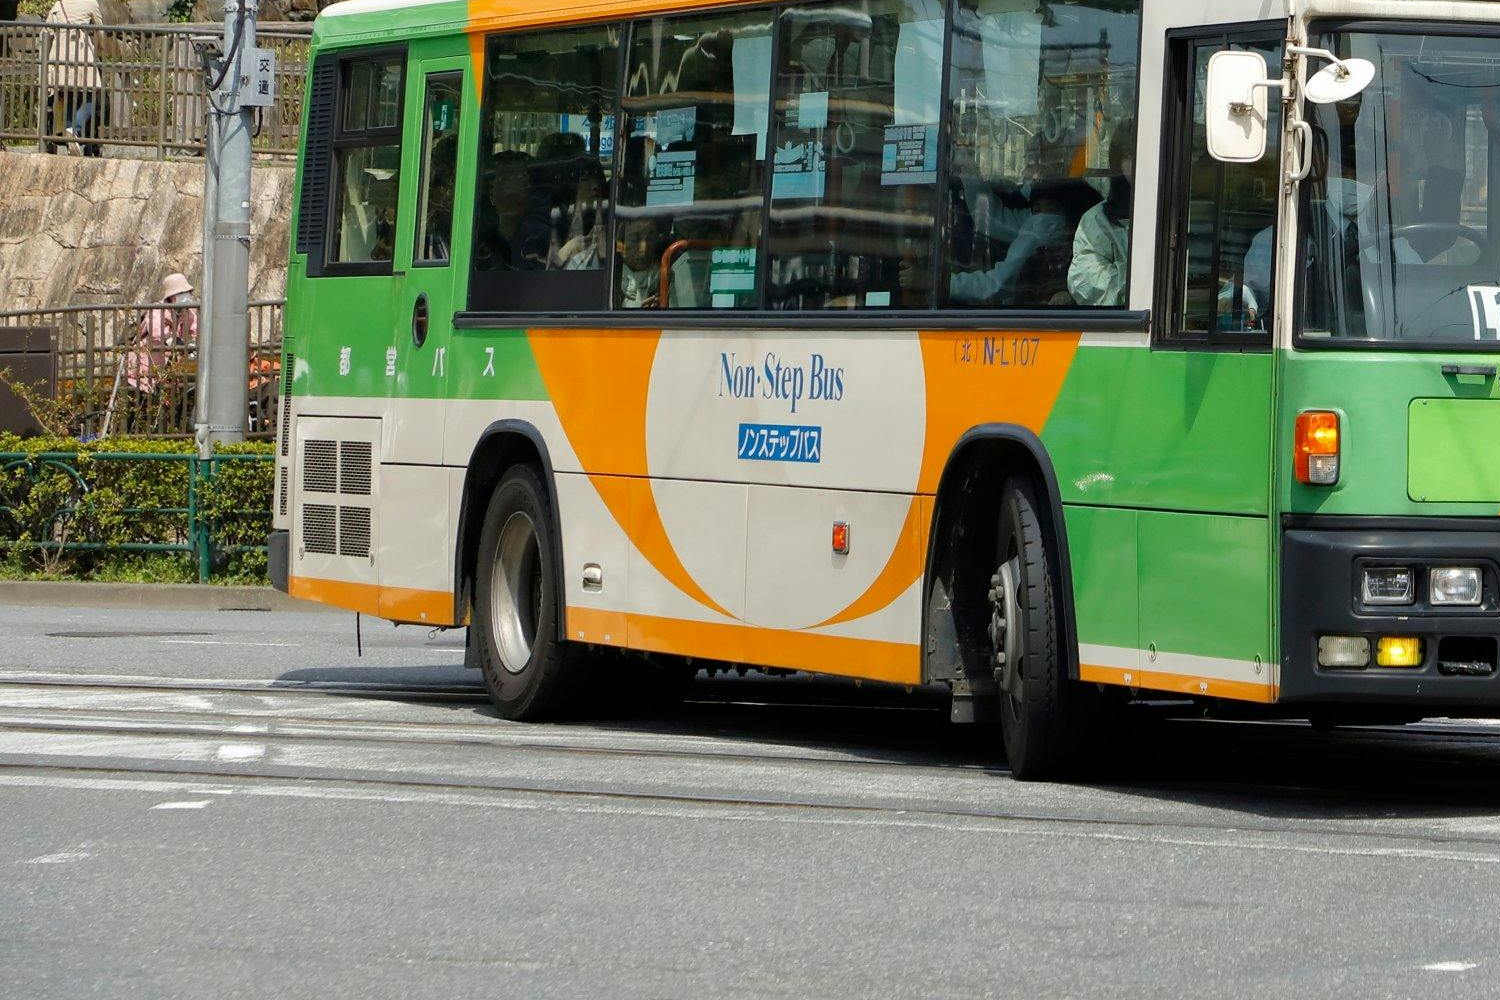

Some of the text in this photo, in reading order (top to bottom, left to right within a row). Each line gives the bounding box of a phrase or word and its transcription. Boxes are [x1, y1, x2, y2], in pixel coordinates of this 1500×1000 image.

[257, 57, 270, 96] 交通
[339, 346, 495, 377] 都営バス
[983, 336, 1040, 366] N-L107
[808, 353, 845, 402] Bus
[739, 428, 820, 460] ノンステップバス
